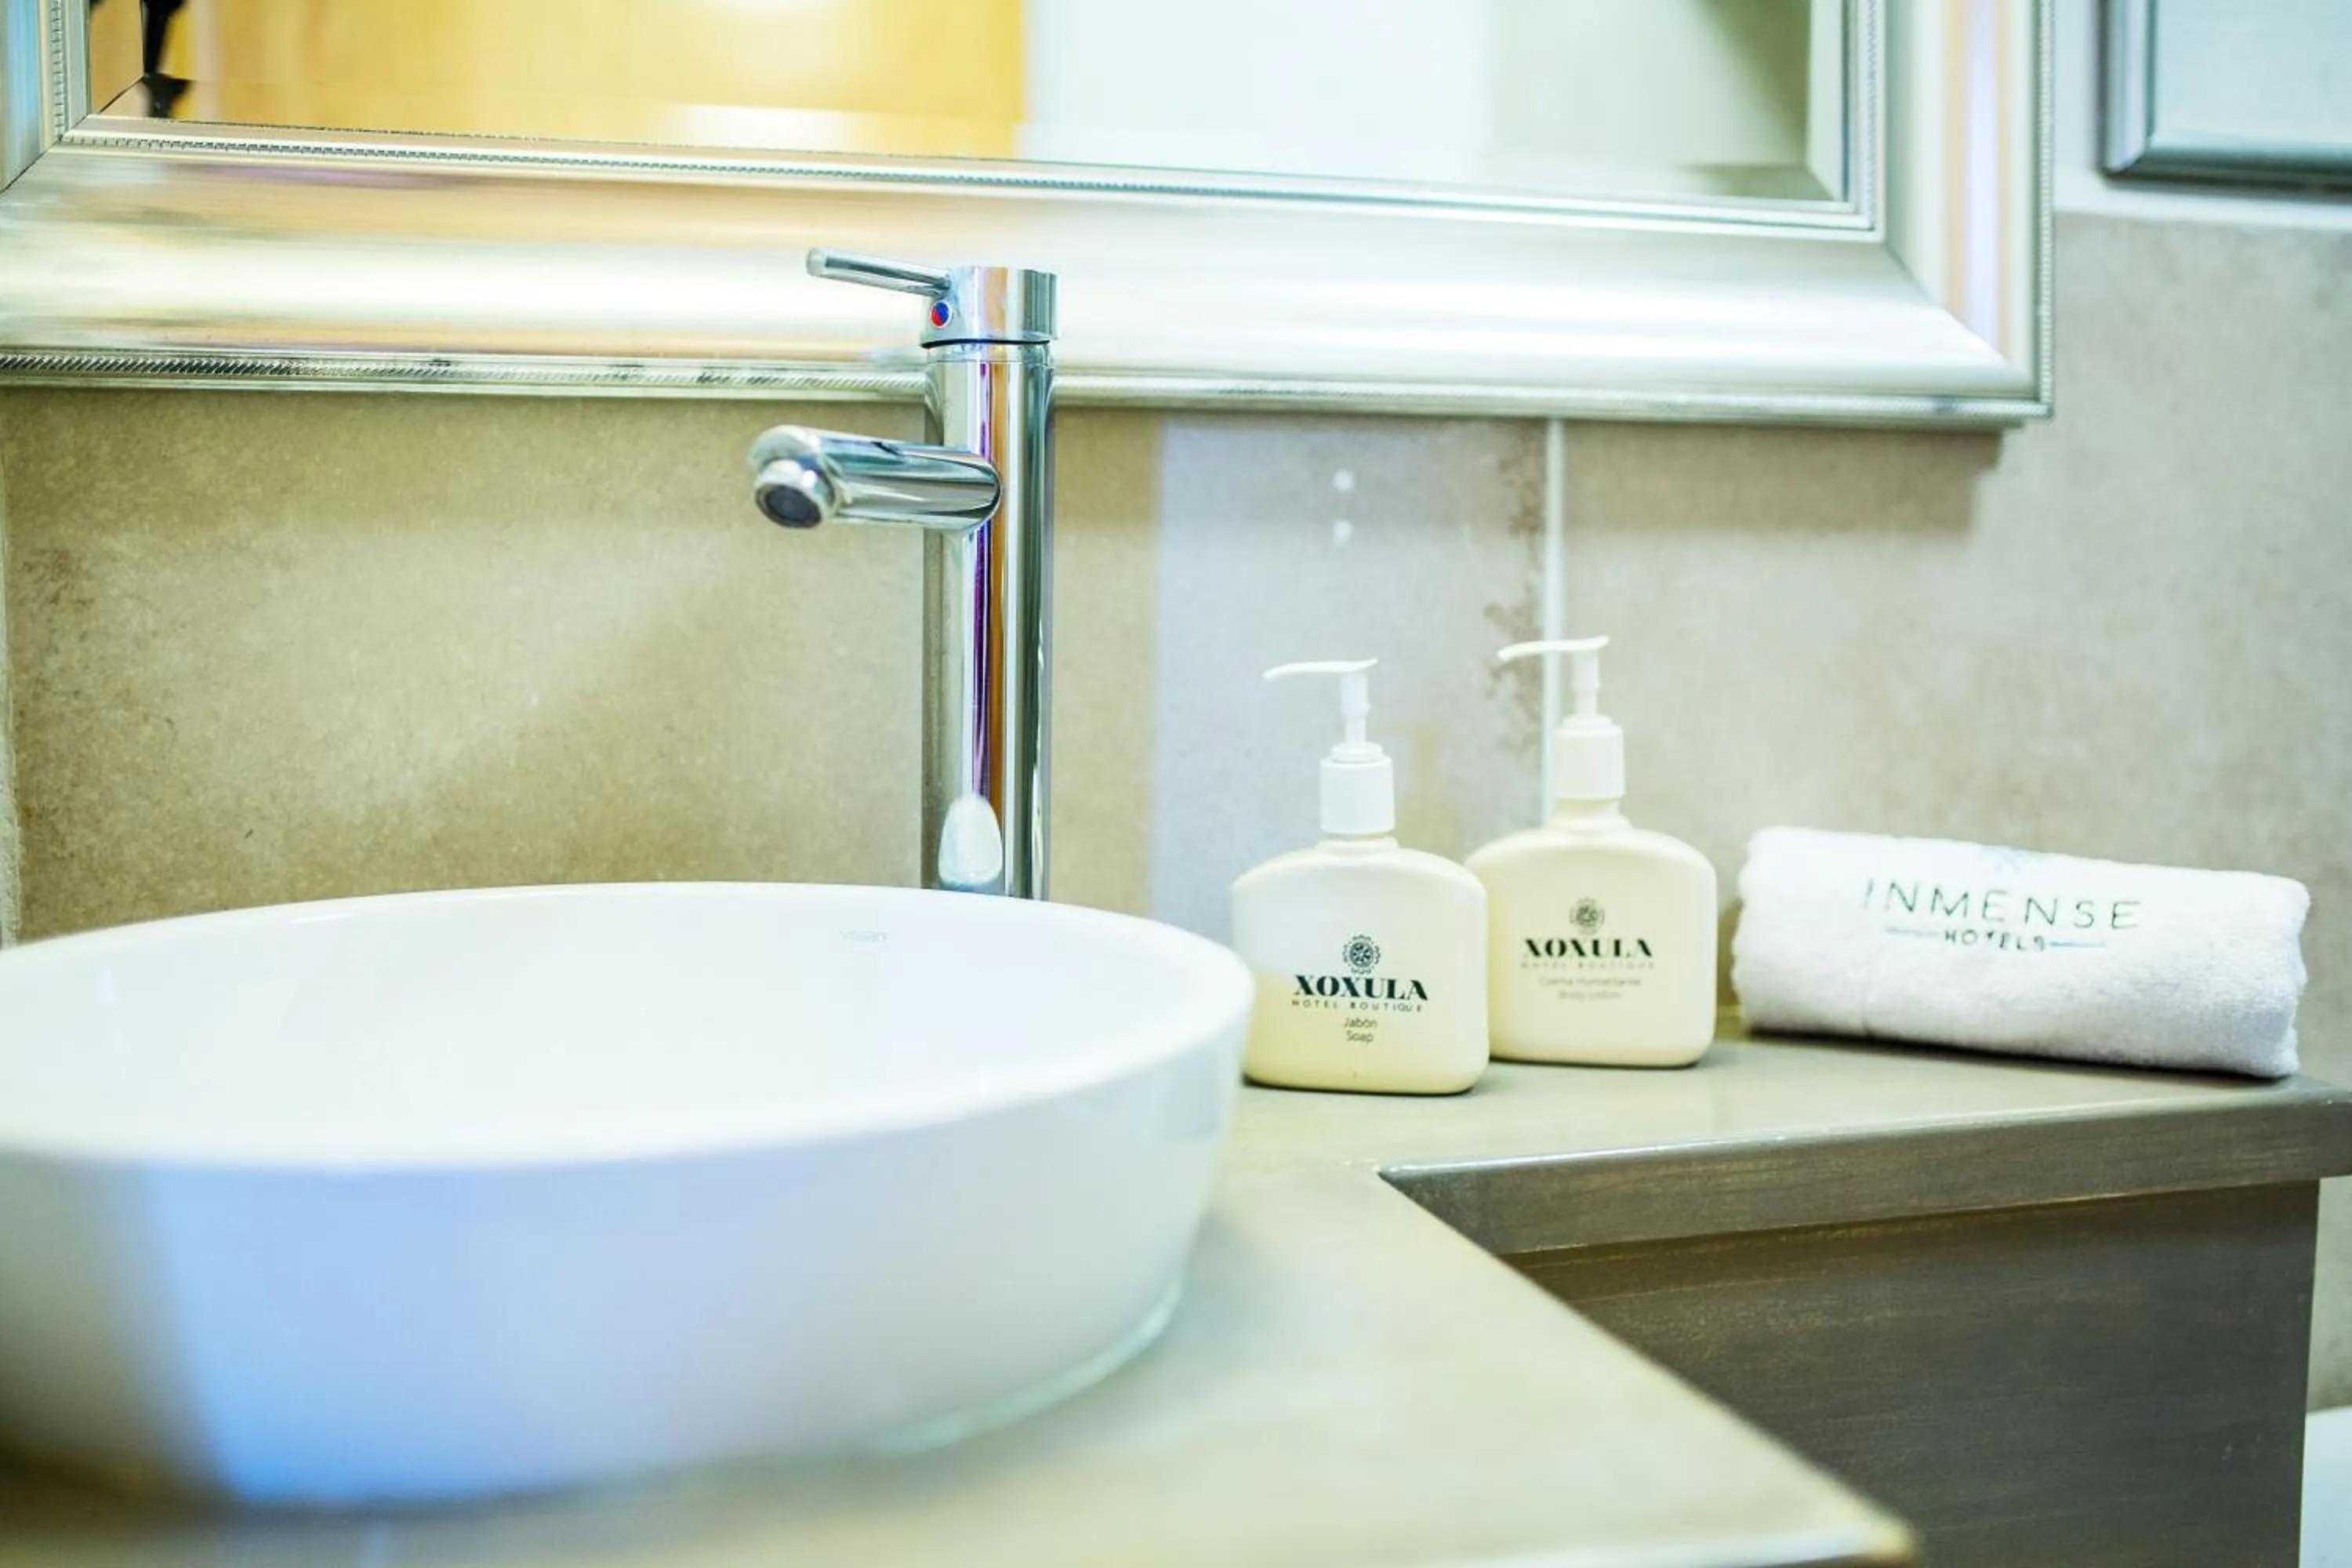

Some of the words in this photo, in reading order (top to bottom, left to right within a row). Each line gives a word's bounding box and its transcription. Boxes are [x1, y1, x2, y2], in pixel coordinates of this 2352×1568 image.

[1863, 878, 2142, 930] INMENSE
[1523, 938, 1653, 958] XOXULA
[1945, 928, 2045, 952] HOTELS
[1294, 975, 1428, 1001] XOXULA
[1292, 1000, 1338, 1010] HOTEL
[1350, 1001, 1422, 1012] BOUTIQUE
[1345, 1029, 1374, 1044] Soap
